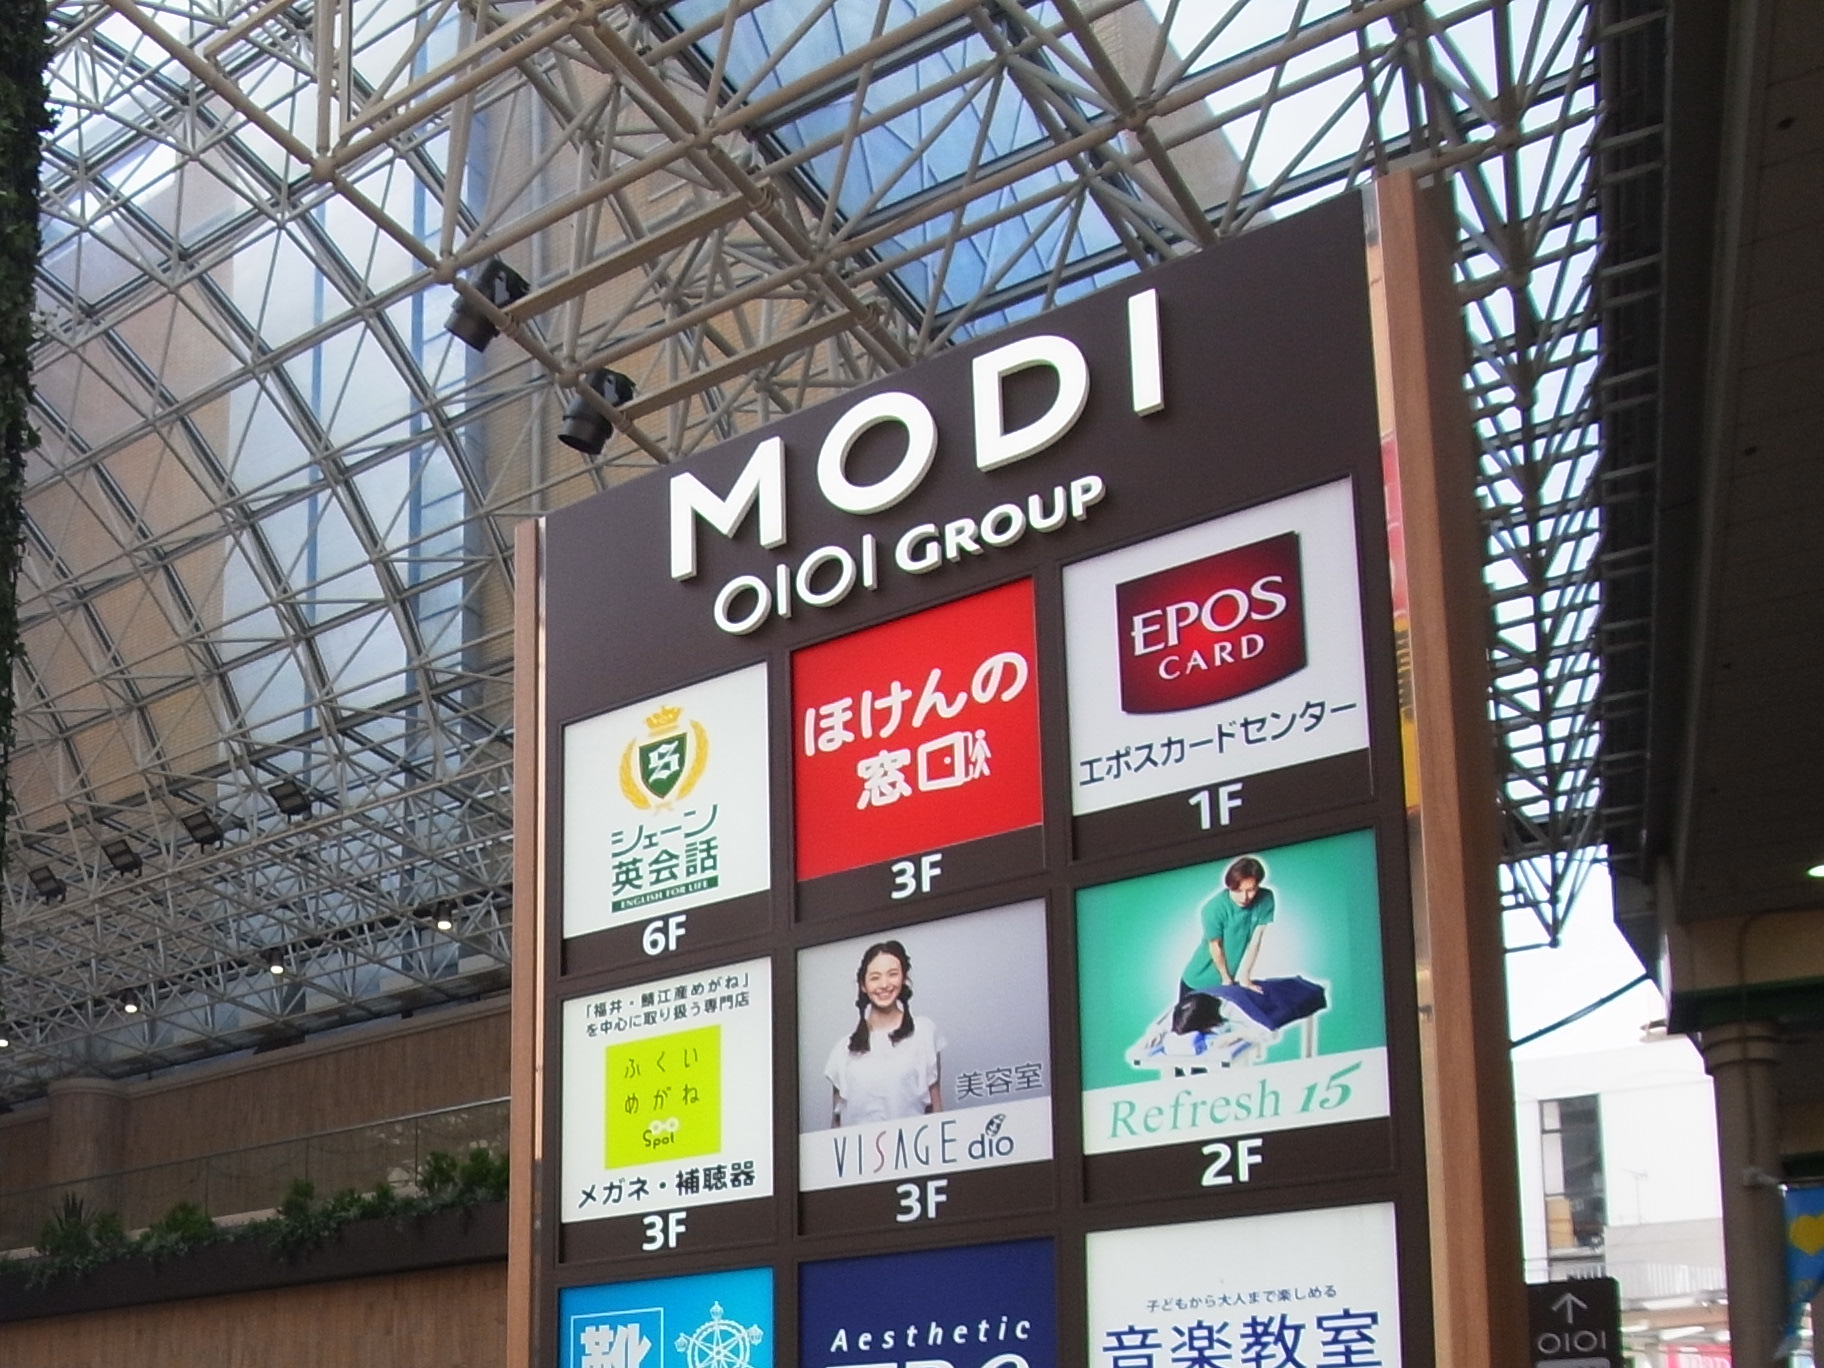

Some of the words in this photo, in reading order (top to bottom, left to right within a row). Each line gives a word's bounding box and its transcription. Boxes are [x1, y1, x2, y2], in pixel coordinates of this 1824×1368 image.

[669, 289, 1164, 582] MODI
[895, 475, 1106, 575] GROUP
[1129, 575, 1288, 656] EPOS
[1157, 631, 1266, 681] CARD
[804, 651, 1029, 757] ほけんの
[1078, 697, 1359, 789] エポスカードセンター
[611, 803, 719, 859] シェーン
[1188, 782, 1243, 832] 1F
[612, 836, 719, 897] 英会話
[890, 853, 943, 899] 3F
[620, 890, 663, 909] ENGLISH
[665, 885, 686, 898] FOR
[642, 914, 687, 956] 6F
[586, 991, 750, 1037] を中心に取り扱う専門店
[624, 1048, 698, 1079] ふくい
[955, 1062, 1044, 1100] 美容室
[624, 1083, 700, 1115] めがね
[1107, 1079, 1281, 1138] Refresh
[1296, 1061, 1363, 1113] 15
[833, 1120, 957, 1178] VISAGE
[967, 1126, 1014, 1160] dio
[1201, 1138, 1263, 1187] 2F
[578, 1160, 755, 1209] メガネ・補聴器
[895, 1178, 948, 1222] 3F
[642, 1211, 687, 1251] 3F
[1146, 1284, 1337, 1313] 子どもから大人まで楽しめる
[830, 1315, 1032, 1353] Aesthetic
